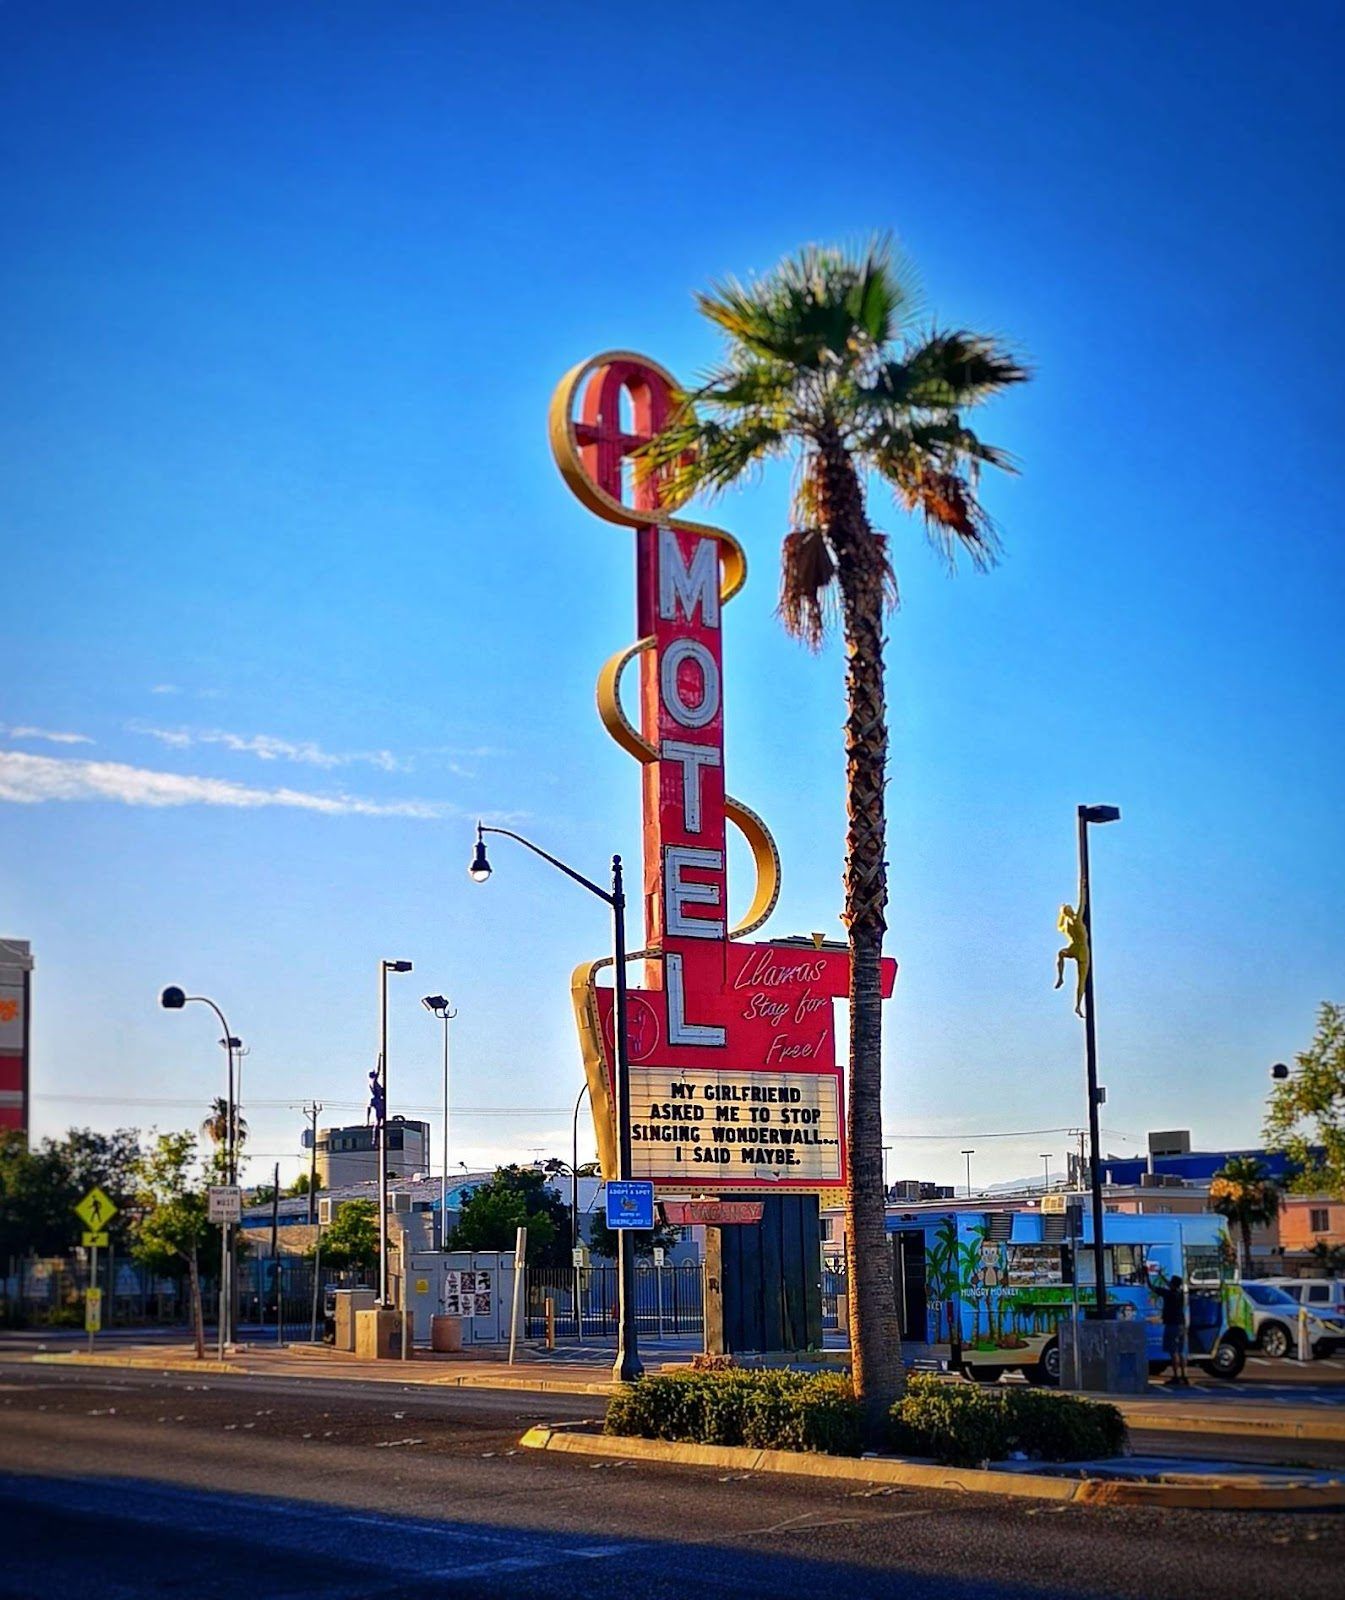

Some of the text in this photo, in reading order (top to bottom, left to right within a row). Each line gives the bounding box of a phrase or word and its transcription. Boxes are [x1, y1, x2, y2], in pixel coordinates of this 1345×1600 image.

[658, 529, 726, 1047] MOTEL
[734, 948, 827, 990] Llamas
[743, 988, 828, 1027] Stay for
[766, 1029, 828, 1064] Free!
[671, 1082, 801, 1103] MY GIRLFRIEND
[650, 1103, 821, 1124] ASKED ME TO STOP
[631, 1124, 839, 1145] SINGING WONDERWALL...
[675, 1146, 801, 1165] I SAID MAYBE.
[690, 1204, 758, 1220] VACANCY
[961, 1287, 1019, 1297] HUNGRY MONKEY
